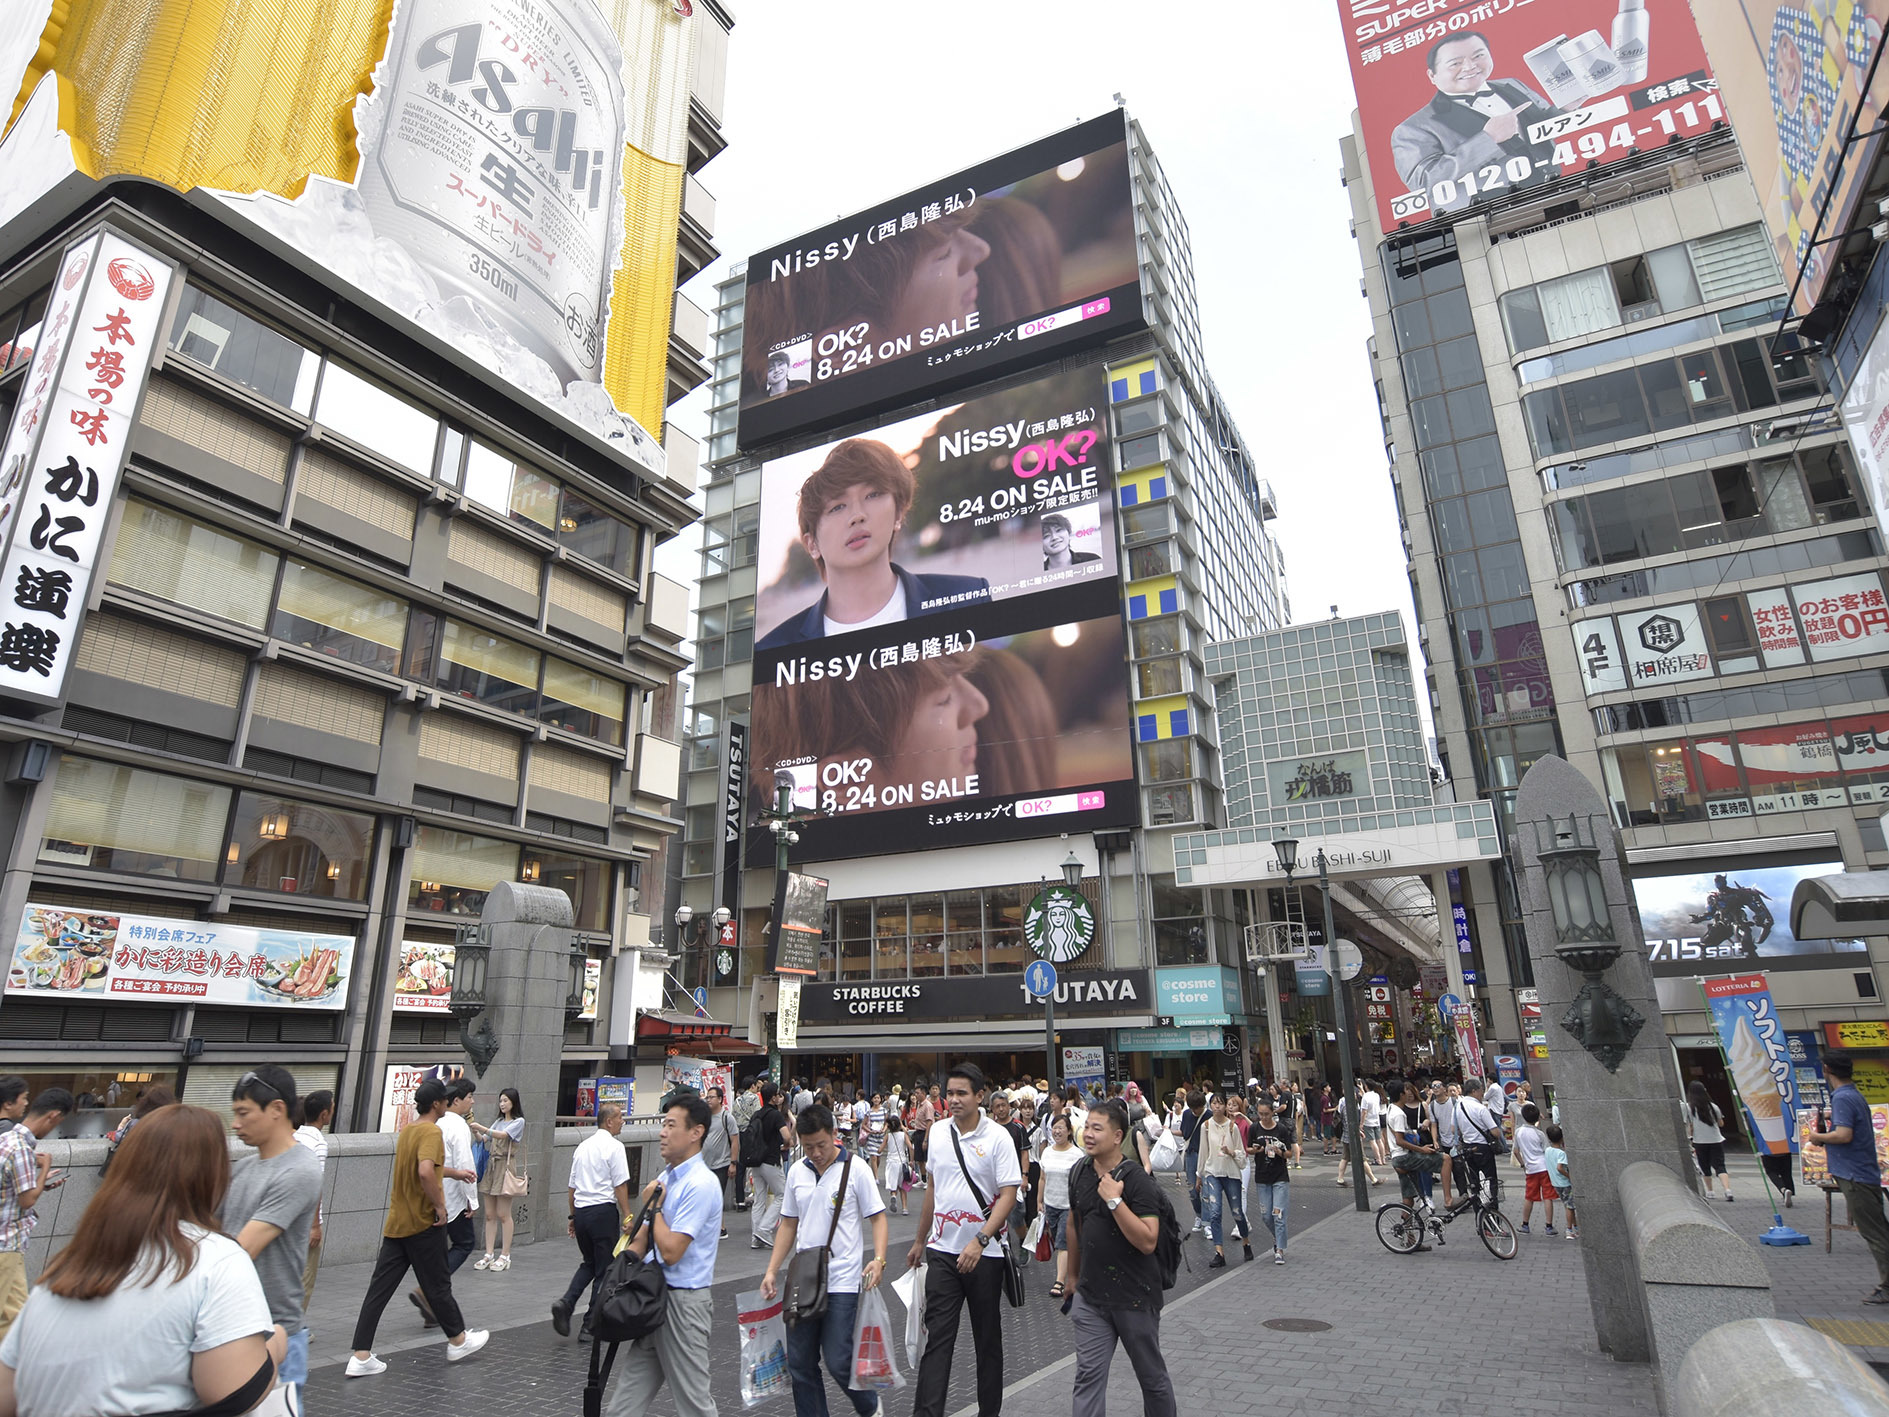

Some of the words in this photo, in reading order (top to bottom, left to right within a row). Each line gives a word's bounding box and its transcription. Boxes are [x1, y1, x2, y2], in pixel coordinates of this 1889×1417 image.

[563, 51, 593, 107] LIMITED
[1646, 78, 1691, 104] 検索
[398, 124, 415, 135] AND
[403, 101, 425, 113] ASAHI
[424, 108, 450, 126] SUPER
[449, 122, 468, 138] DRY
[416, 22, 604, 212] Asahi
[429, 120, 452, 137] USING
[1535, 112, 1593, 140] ルアン
[480, 152, 535, 220] 生
[446, 172, 557, 266] スーパードライ
[474, 214, 525, 259] 生ビール
[770, 232, 859, 282] Nissy
[866, 187, 976, 245] (西島隆弘)
[469, 253, 519, 303] 350ml
[566, 304, 600, 361] お酒
[1024, 316, 1056, 336] OK?
[1086, 302, 1105, 315] 検索
[816, 343, 873, 380] 8.24
[878, 335, 912, 360] ON
[919, 311, 980, 346] SALE
[817, 322, 870, 356] OK?
[70, 306, 136, 446] 本場の味
[939, 419, 1026, 462] Nissy
[1012, 429, 1097, 479] OK?
[939, 495, 985, 523] 8.24
[990, 484, 1027, 510] ON
[1033, 466, 1098, 500] SALE
[776, 652, 862, 688] Nissy
[869, 629, 976, 670] (西島隆弘)
[1635, 653, 1699, 679] 相席屋
[1800, 744, 1833, 760] 鶴橋
[822, 758, 873, 787] OK?
[1297, 760, 1336, 776] なんば
[726, 734, 743, 842] TSUTAYA
[821, 784, 876, 814] 8.24
[881, 784, 913, 806] ON
[920, 774, 979, 801] SALE
[1285, 771, 1353, 801] 戎橋筋
[1022, 799, 1052, 815] OK?
[1081, 795, 1100, 806] 検索
[1708, 800, 1750, 817] 営業時間
[1757, 801, 1775, 811] AM
[129, 925, 217, 945] 特別会席フェア
[722, 924, 734, 942] 本
[1453, 907, 1472, 953] 時計倉
[115, 943, 268, 980] かに彩造り会席
[1645, 937, 1702, 961] 7.15
[1705, 942, 1749, 958] sat.
[114, 979, 162, 993] 各種ご宴会
[164, 983, 206, 994] 予約承り中
[833, 985, 921, 1000] STARBUCKS
[1161, 979, 1216, 991] @cosme
[1171, 991, 1209, 1003] store
[1711, 983, 1749, 993] LOTTERIA
[849, 1000, 904, 1014] COFFEE
[1367, 1004, 1387, 1016] 免税
[1161, 1018, 1170, 1026] 3F
[394, 1072, 422, 1088] かに
